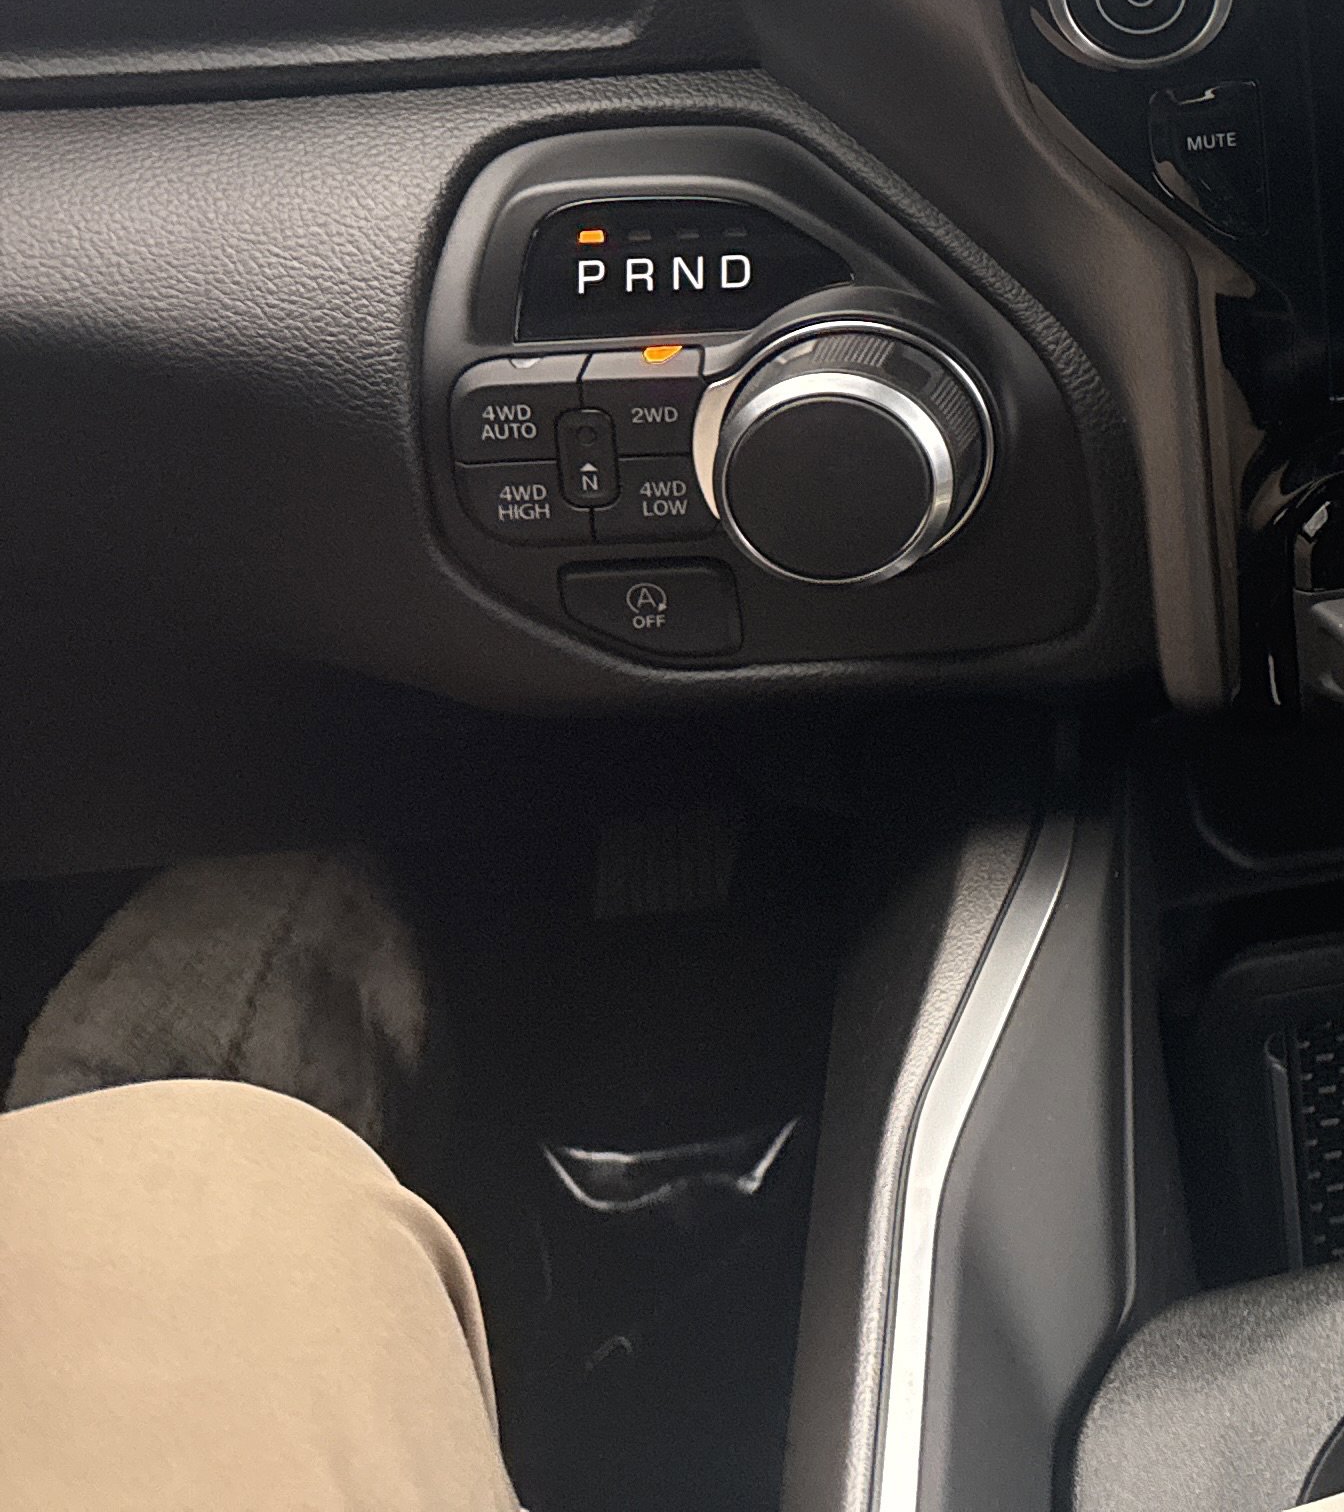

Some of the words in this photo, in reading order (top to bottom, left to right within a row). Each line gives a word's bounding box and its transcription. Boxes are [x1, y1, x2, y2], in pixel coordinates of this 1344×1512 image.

[1187, 132, 1237, 151] MUTE
[577, 260, 606, 294] P
[625, 258, 655, 292] R
[672, 256, 705, 290] N
[721, 254, 752, 288] D
[482, 404, 532, 422] 4WD
[631, 407, 679, 423] 2WD
[481, 421, 537, 441] AUTO
[582, 473, 598, 492] N
[640, 480, 687, 498] 4WD
[499, 484, 546, 502] 4WD
[499, 502, 550, 520] HIGH
[642, 499, 687, 517] LOW
[632, 614, 666, 629] OFF
